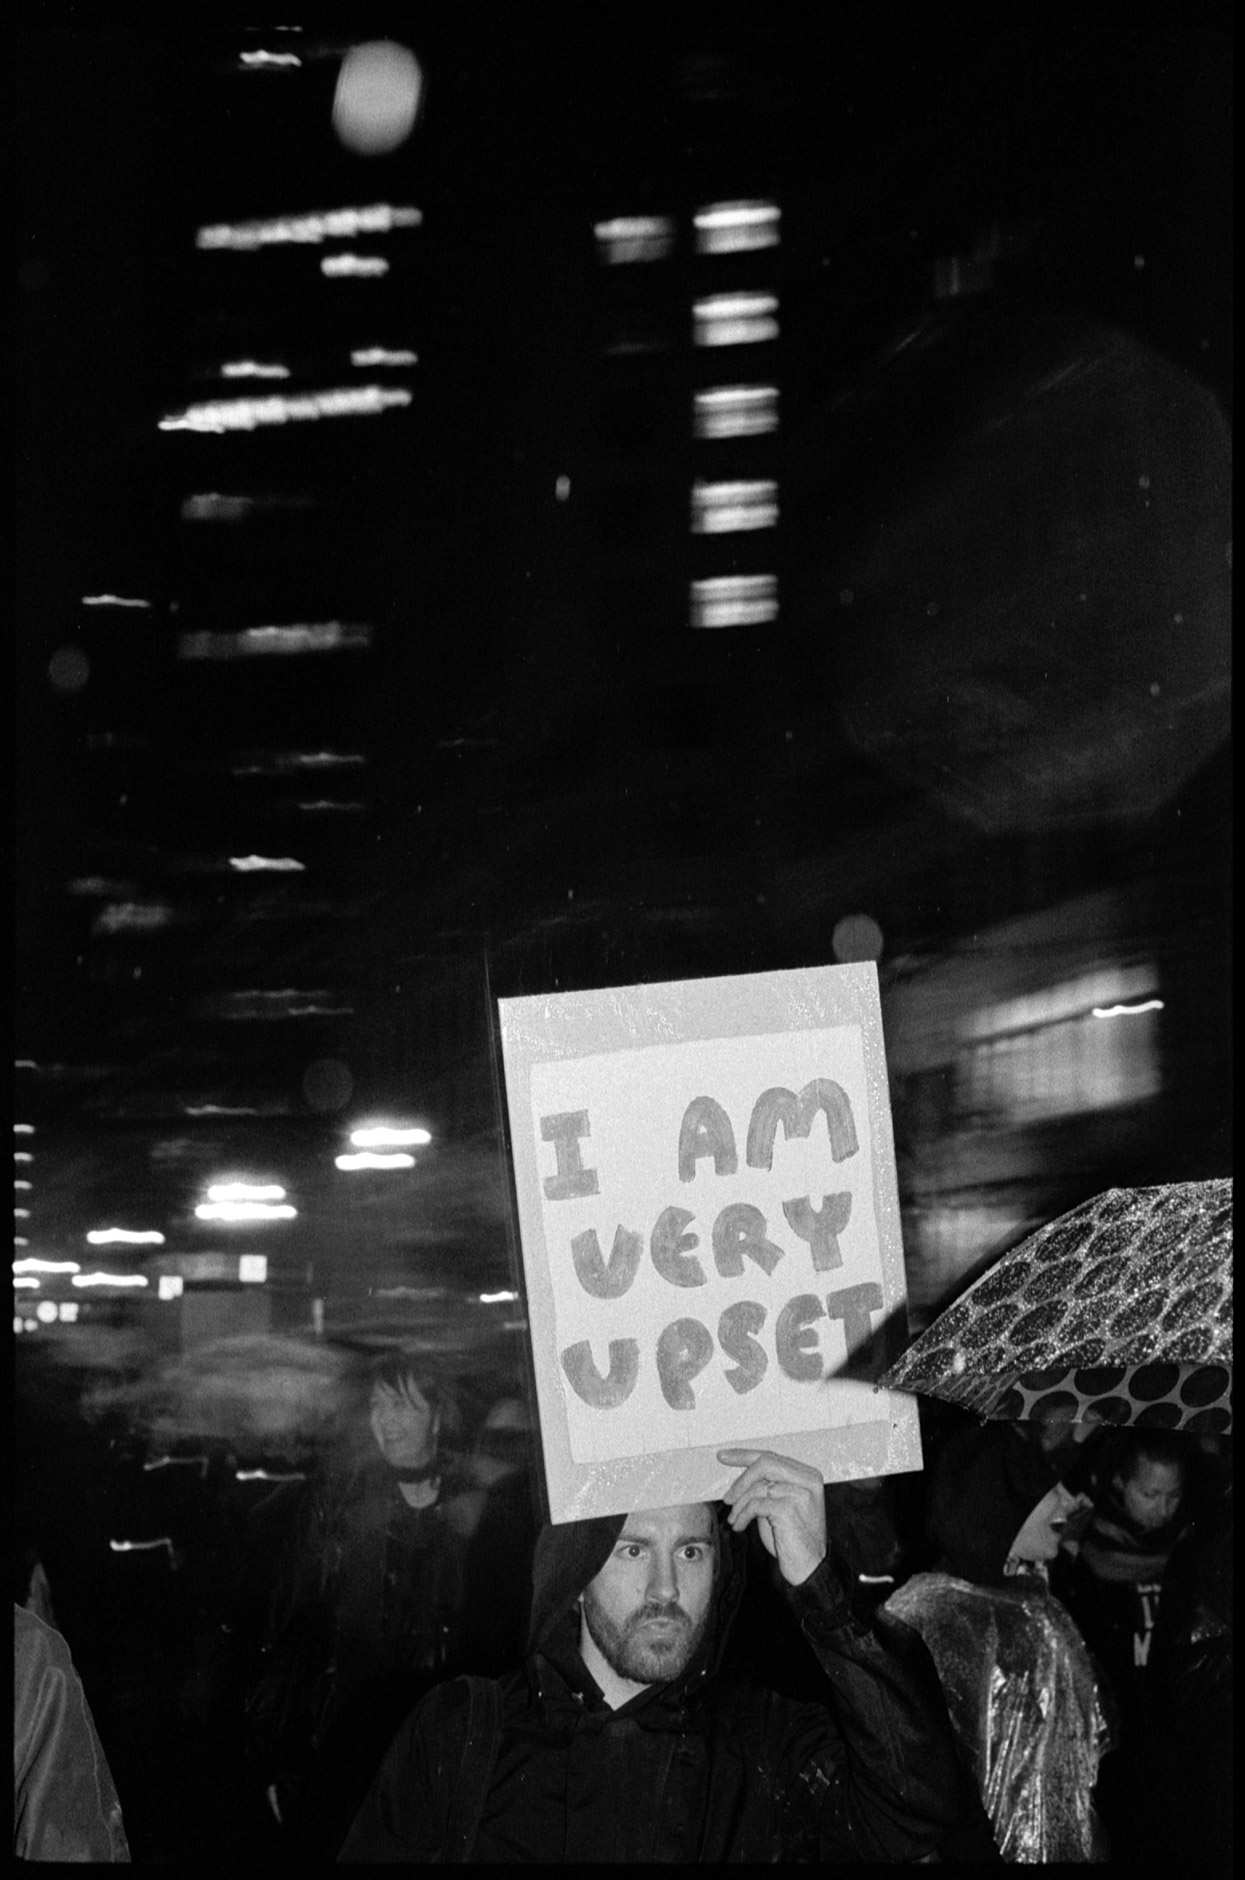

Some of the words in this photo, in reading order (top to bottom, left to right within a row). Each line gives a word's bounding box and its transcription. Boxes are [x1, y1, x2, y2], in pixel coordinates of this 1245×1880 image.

[540, 1109, 600, 1200] I
[678, 1077, 859, 1183] AM
[570, 1192, 853, 1300] VERY
[561, 1282, 884, 1411] UPSET
